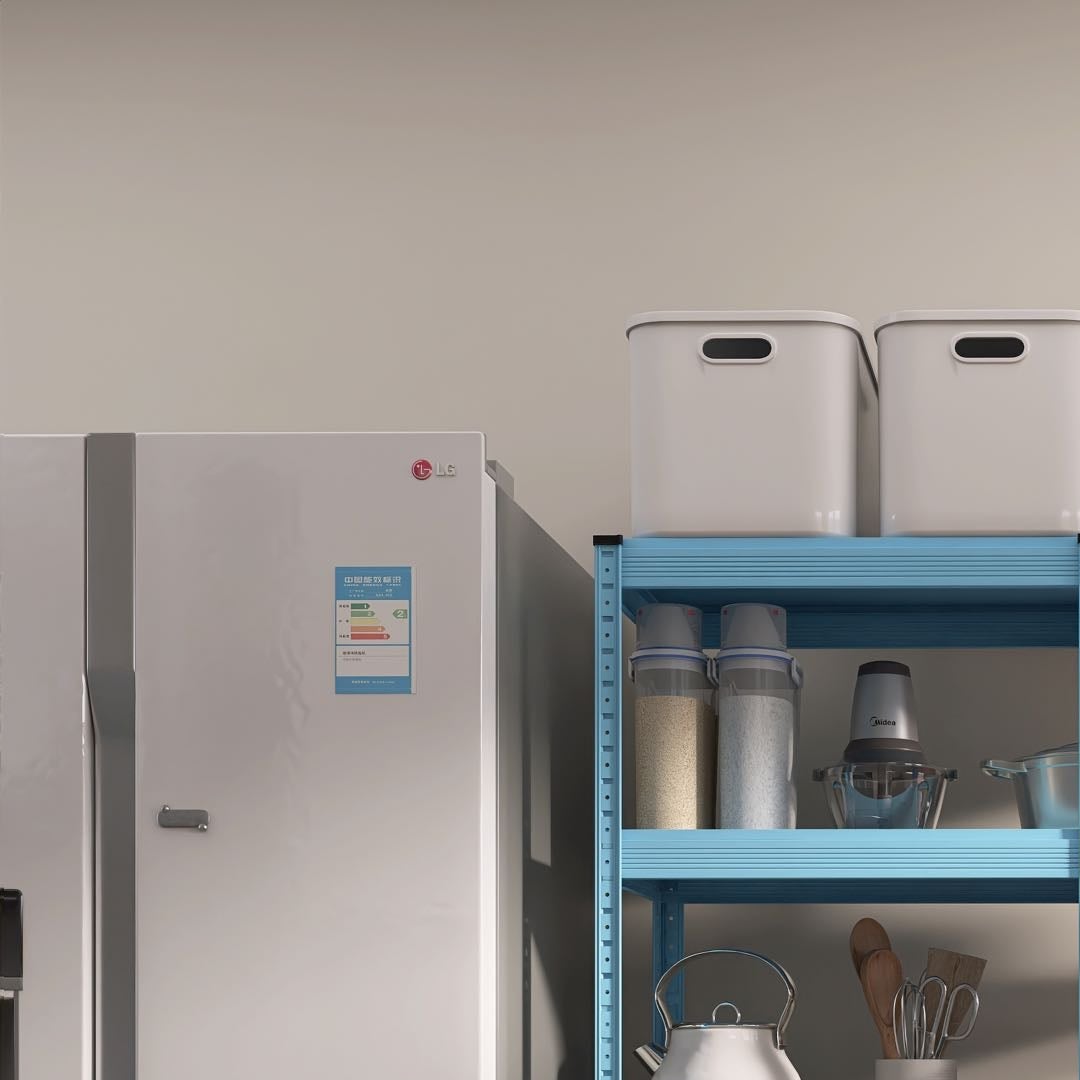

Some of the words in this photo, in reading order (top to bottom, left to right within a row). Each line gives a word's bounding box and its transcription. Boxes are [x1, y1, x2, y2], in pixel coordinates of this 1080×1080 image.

[435, 462, 457, 477] LG
[396, 610, 405, 618] 2
[870, 716, 896, 727] Midea
